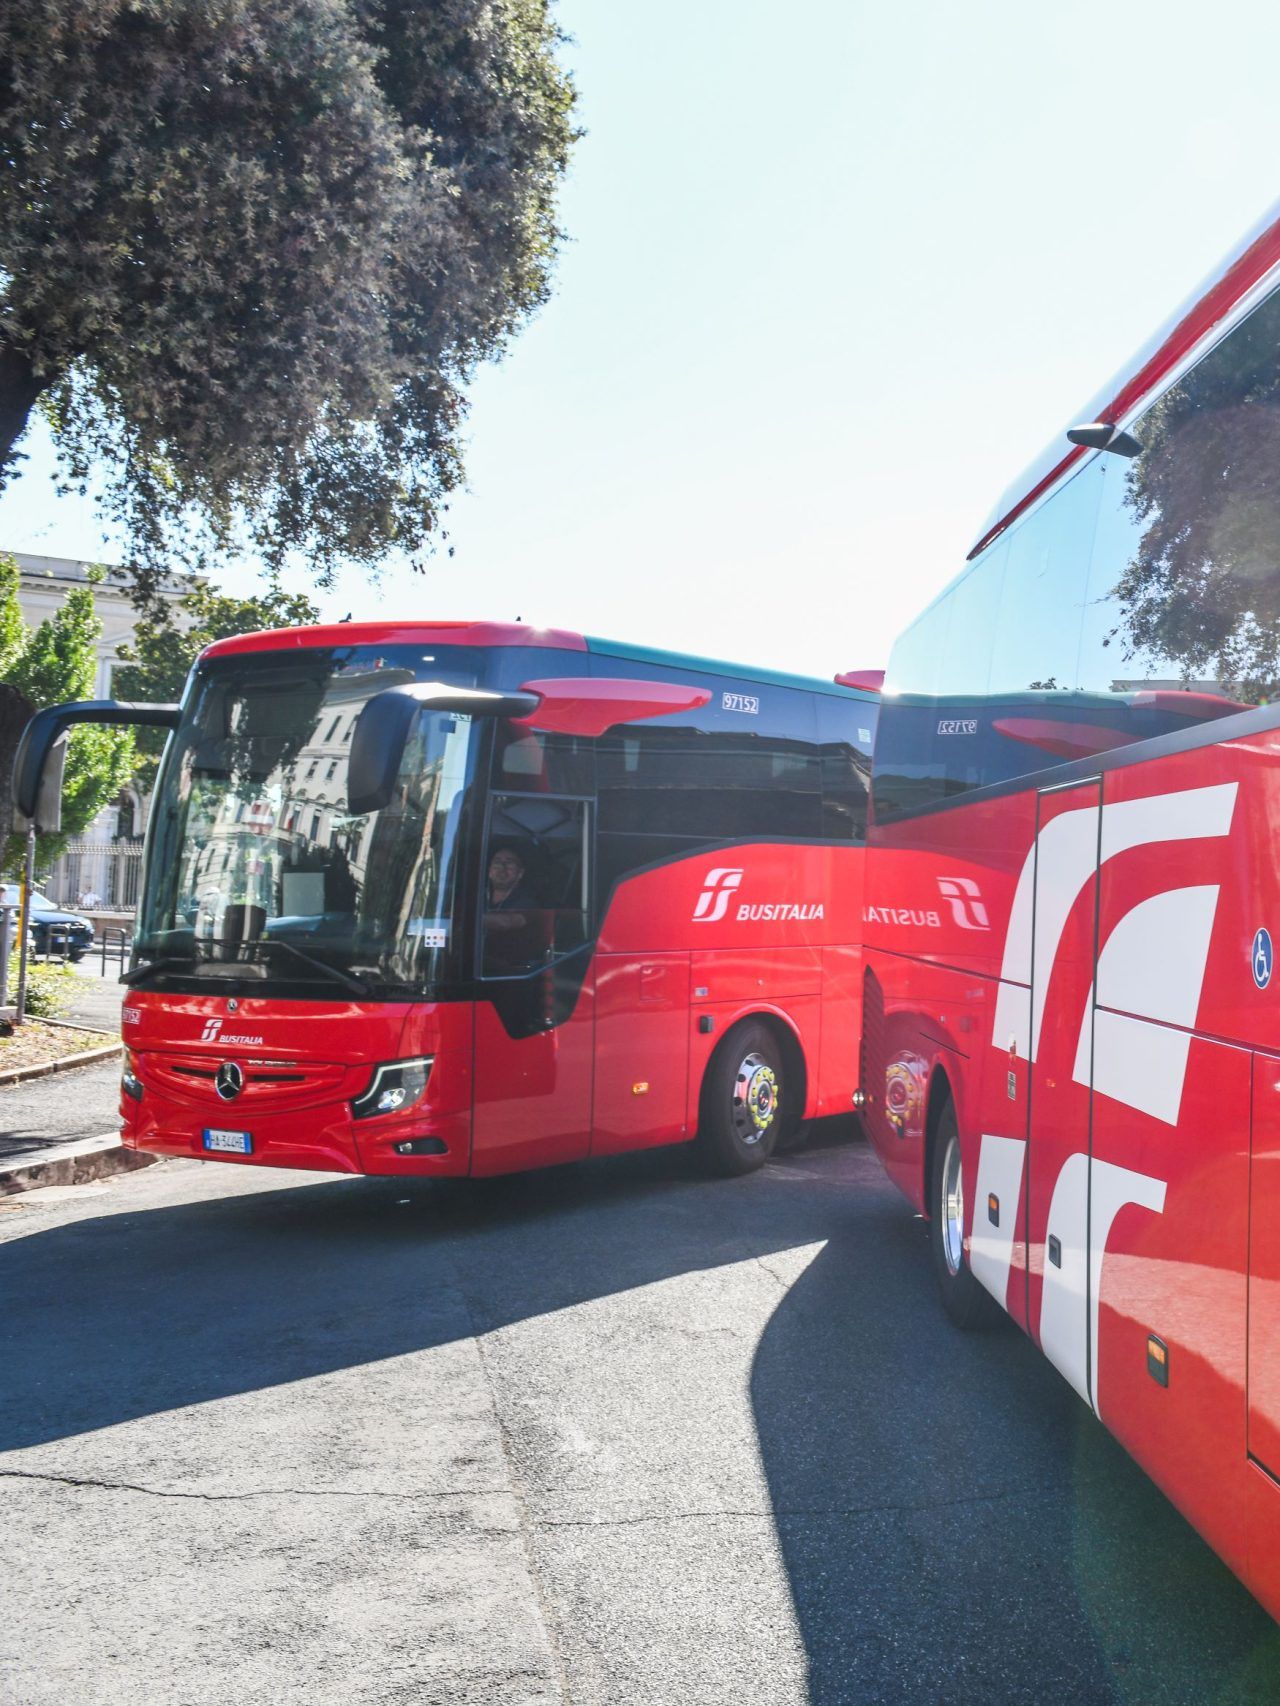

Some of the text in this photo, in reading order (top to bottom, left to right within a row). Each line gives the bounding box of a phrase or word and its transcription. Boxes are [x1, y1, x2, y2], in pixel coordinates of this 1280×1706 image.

[724, 694, 757, 712] 97152
[736, 904, 824, 921] BUSITALIA
[219, 1034, 263, 1045] BUSITALIA
